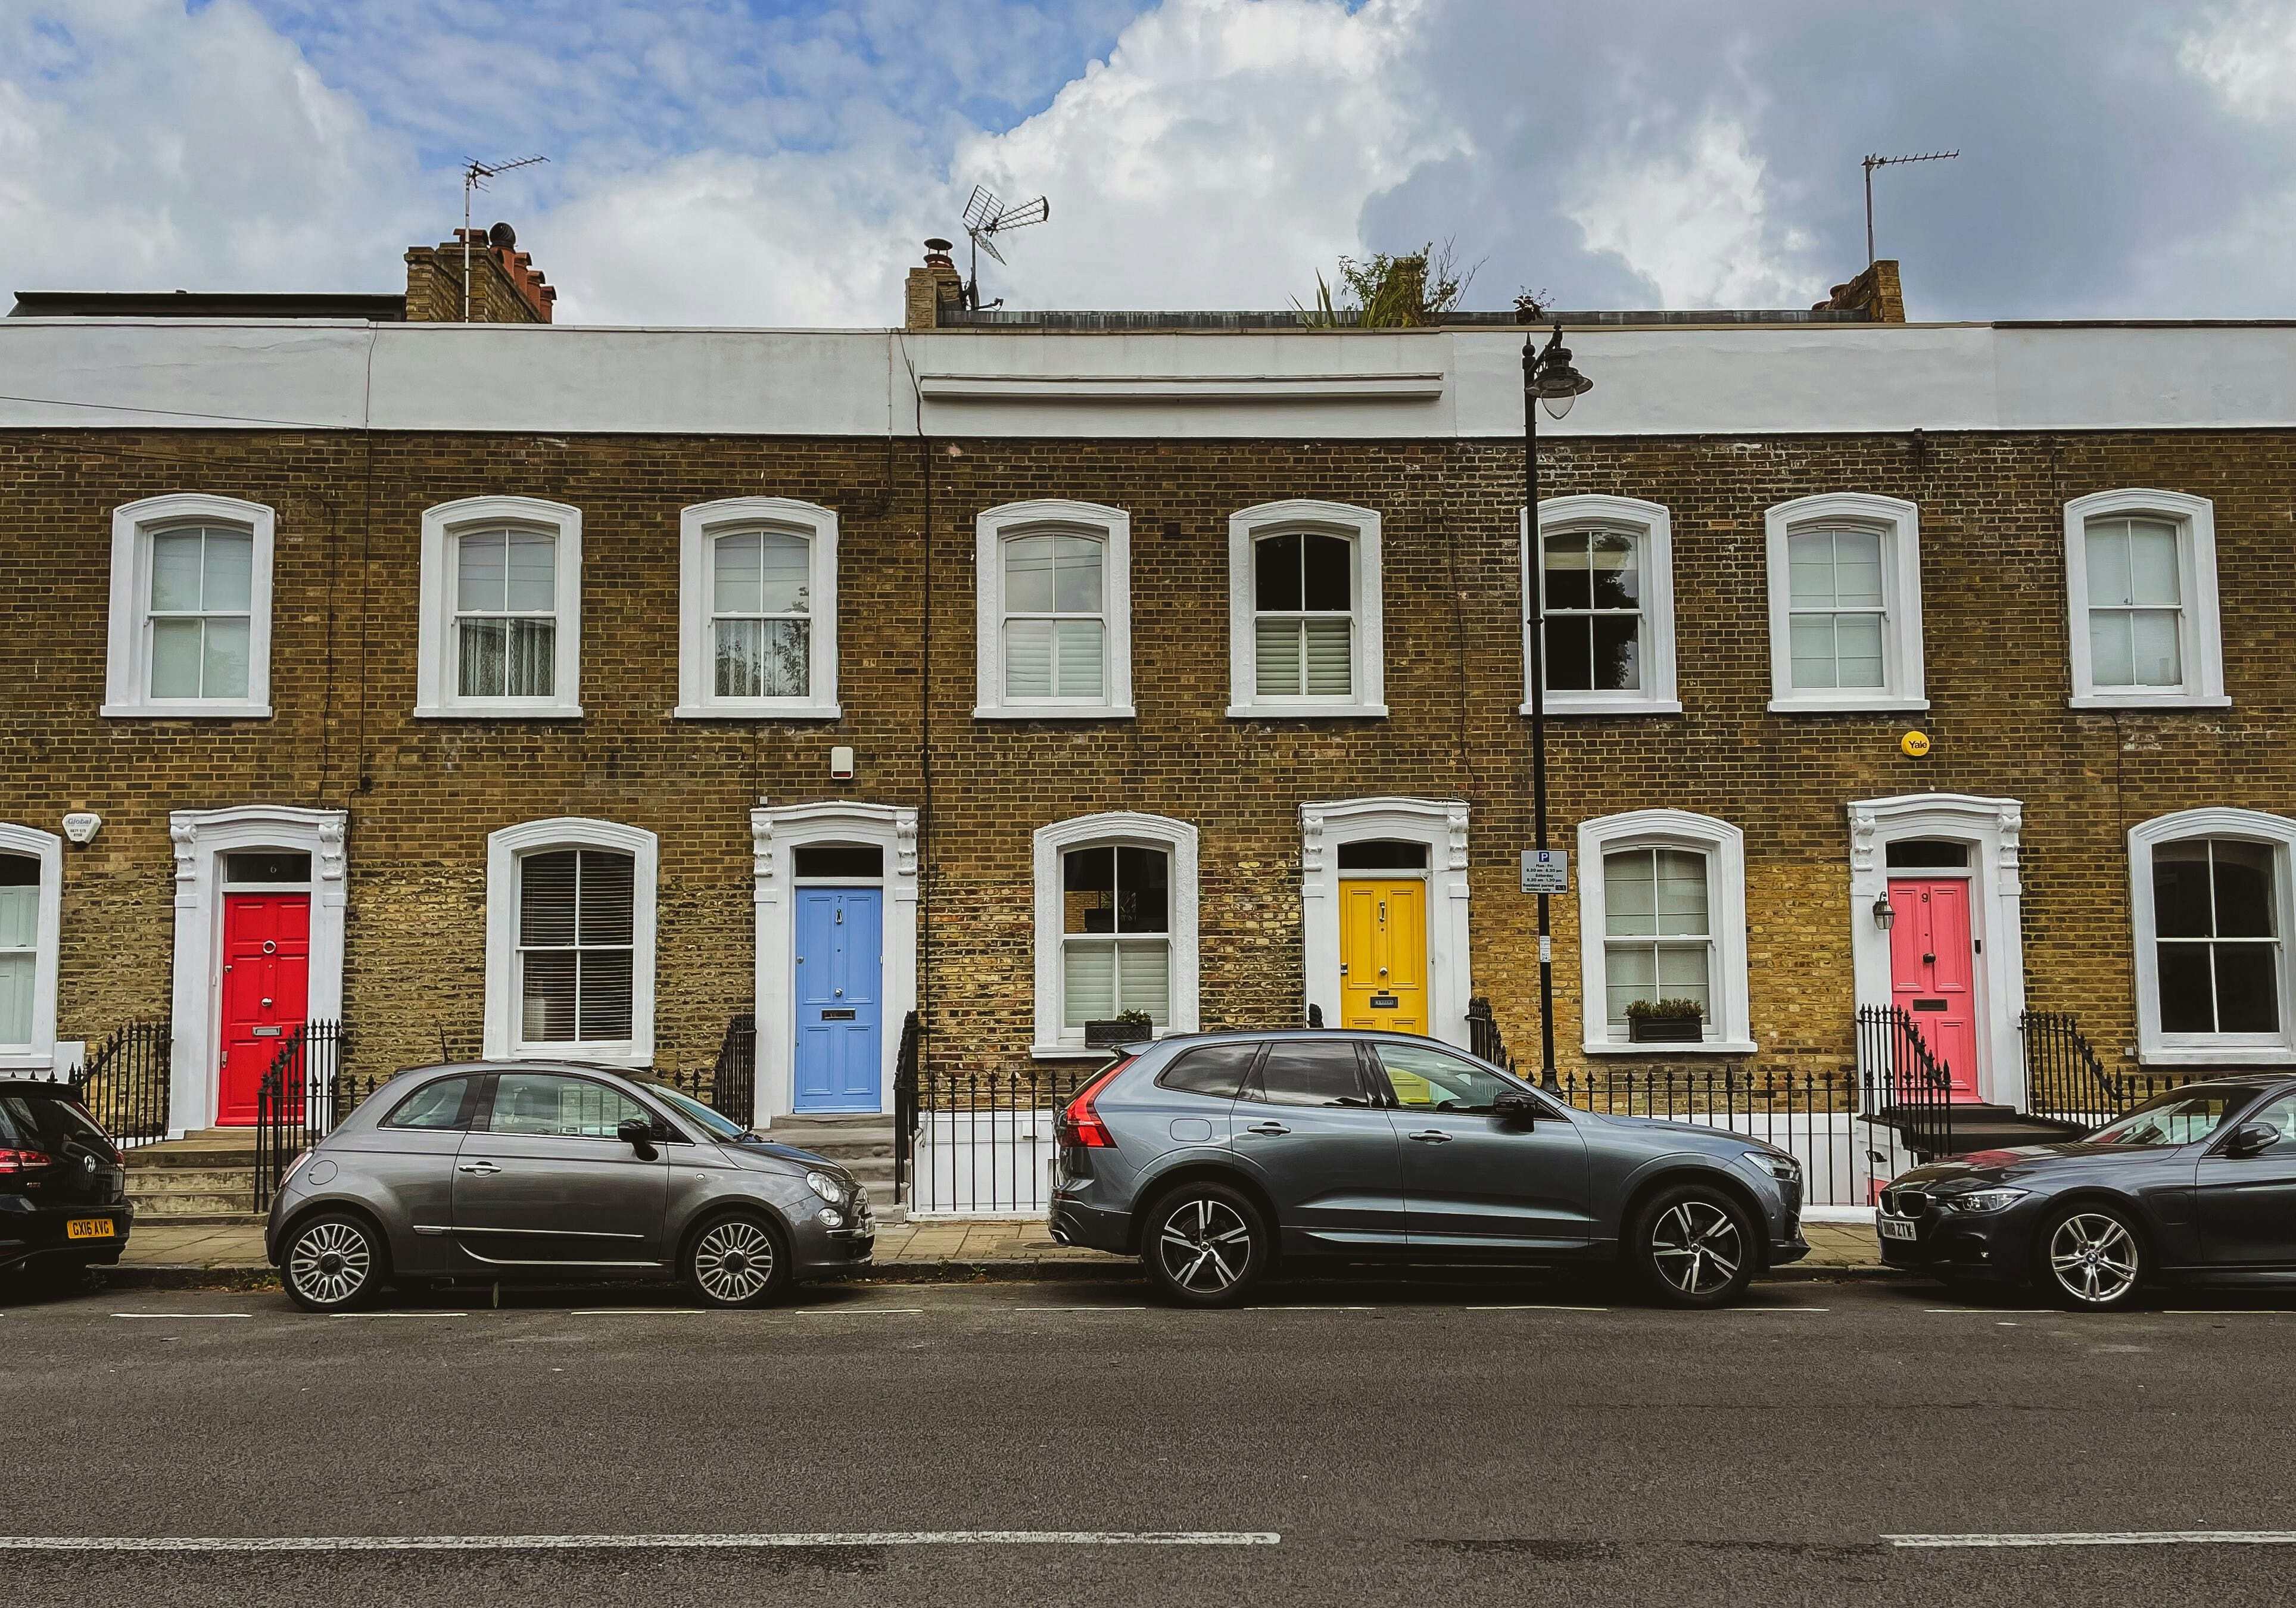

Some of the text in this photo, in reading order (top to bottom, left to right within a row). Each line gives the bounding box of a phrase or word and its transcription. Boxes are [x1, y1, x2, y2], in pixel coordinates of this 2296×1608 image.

[1541, 853, 1548, 861] P
[1921, 893, 1929, 903] 9
[73, 1221, 110, 1236] GX16 AVG
